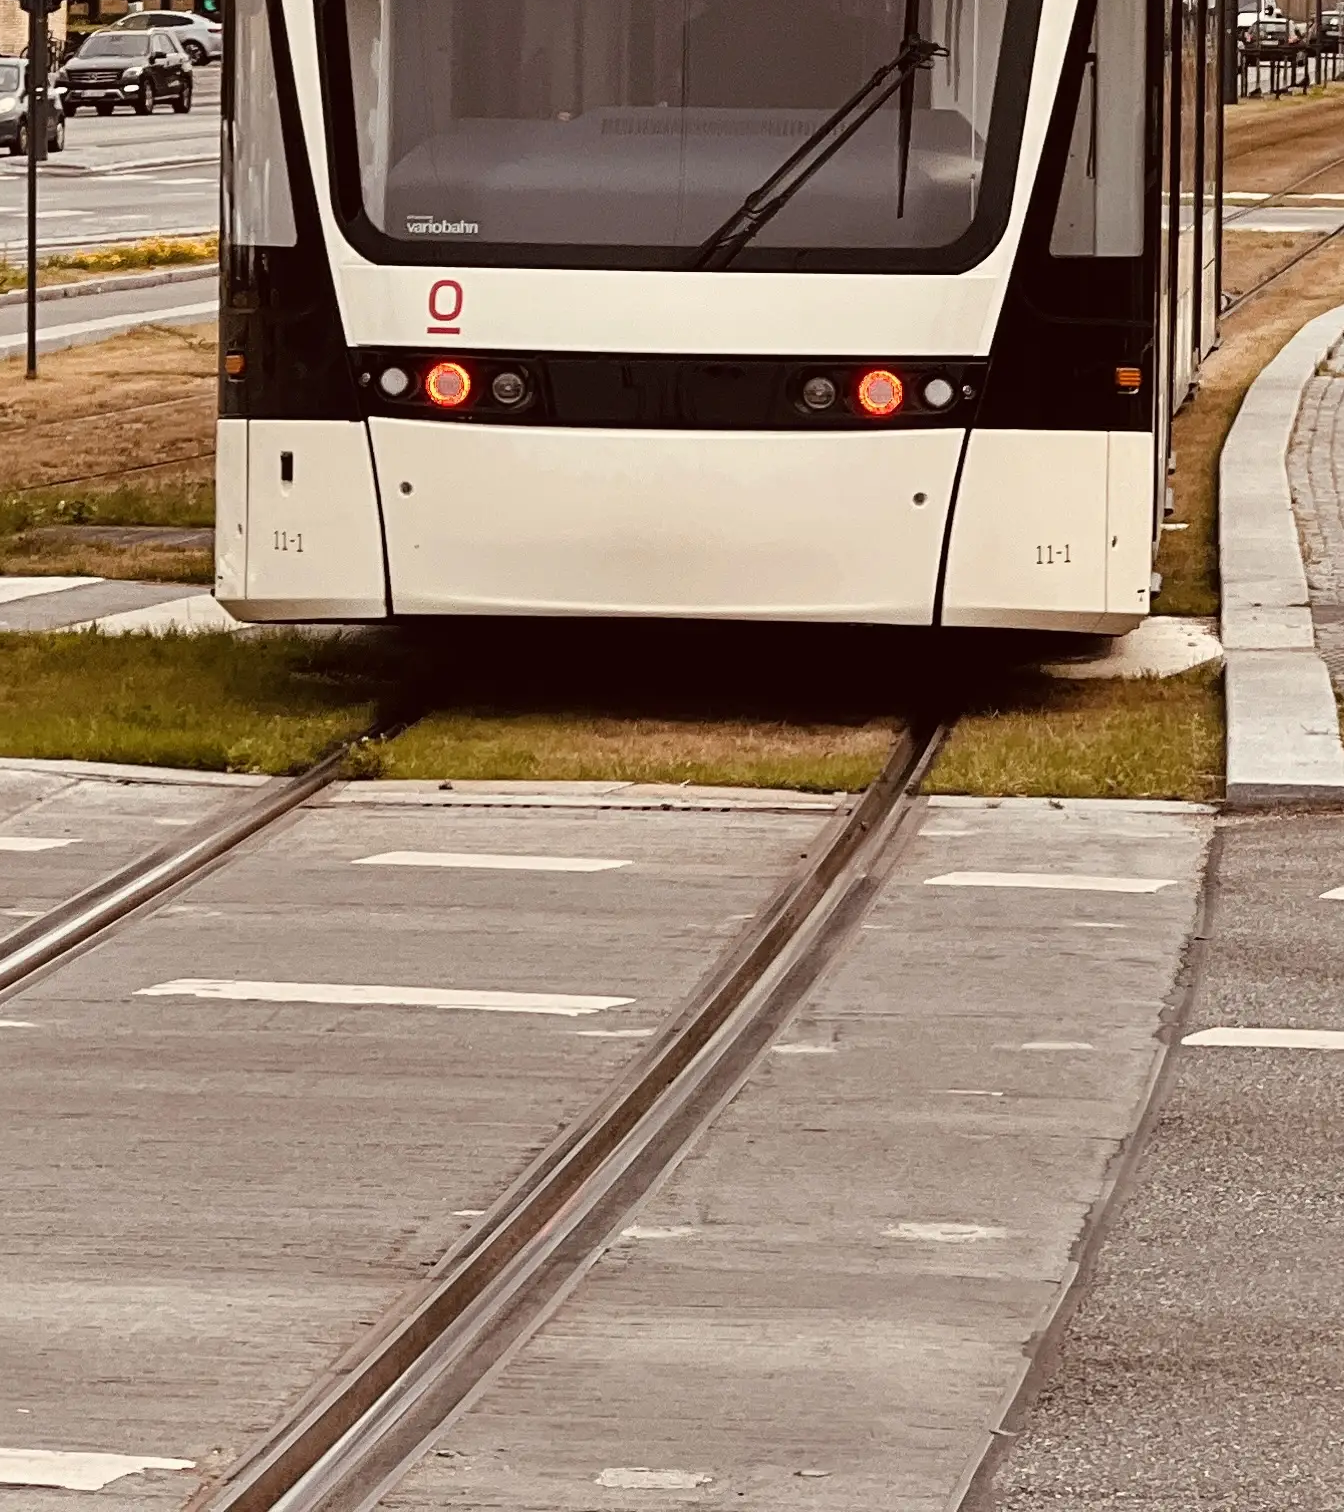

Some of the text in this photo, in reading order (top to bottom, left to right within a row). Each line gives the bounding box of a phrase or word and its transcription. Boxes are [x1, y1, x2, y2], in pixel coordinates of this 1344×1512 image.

[406, 219, 479, 234] variobahn
[273, 530, 304, 553] 11-1
[1036, 543, 1072, 565] 11-1
